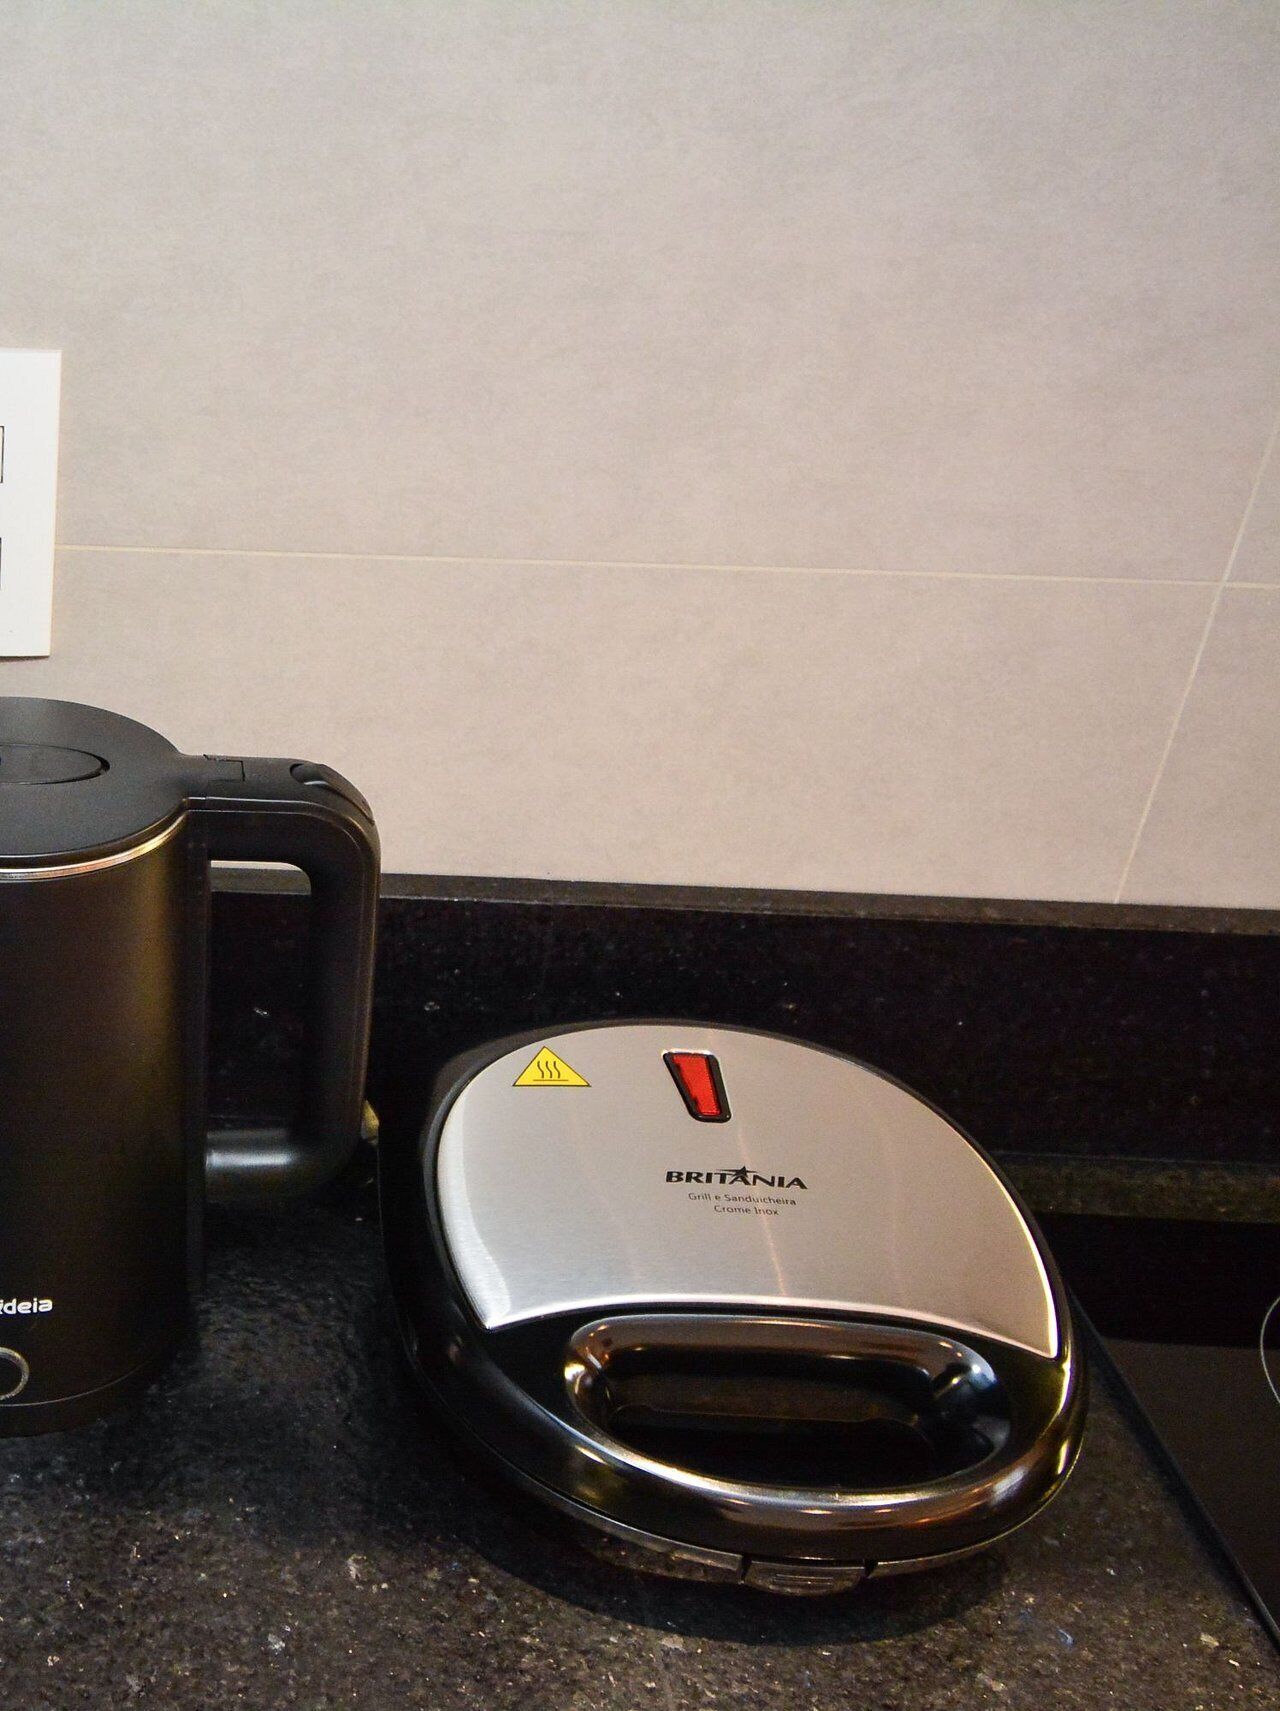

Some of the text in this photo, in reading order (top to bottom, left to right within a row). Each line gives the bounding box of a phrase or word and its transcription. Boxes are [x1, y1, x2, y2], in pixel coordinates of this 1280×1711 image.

[688, 1192, 712, 1201] Grill
[724, 1193, 797, 1206] Sanduicheira
[714, 1205, 779, 1216] Crome Inox
